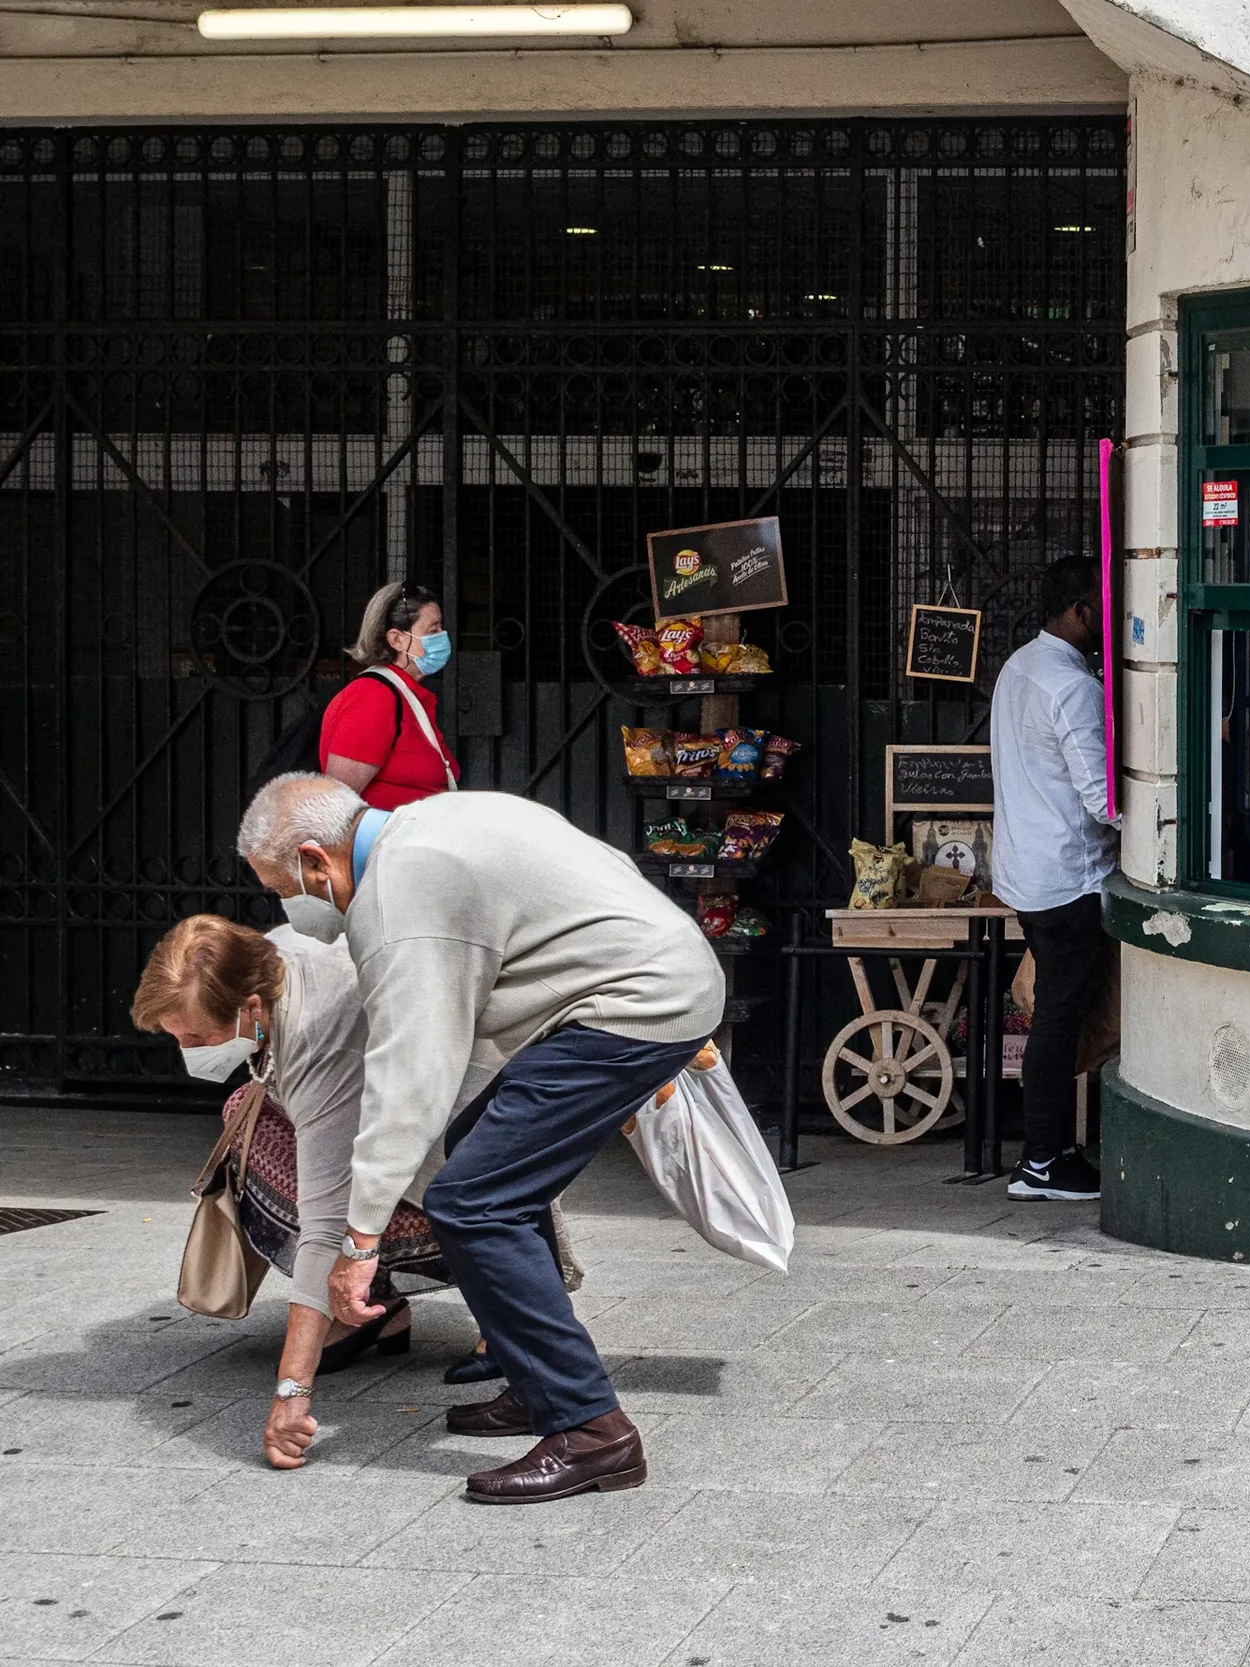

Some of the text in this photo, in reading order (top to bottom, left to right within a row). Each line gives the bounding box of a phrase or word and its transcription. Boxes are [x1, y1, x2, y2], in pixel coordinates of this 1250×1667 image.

[1214, 484, 1233, 492] ALQUILA
[675, 551, 700, 569] Lay's
[661, 628, 693, 644] Lay's
